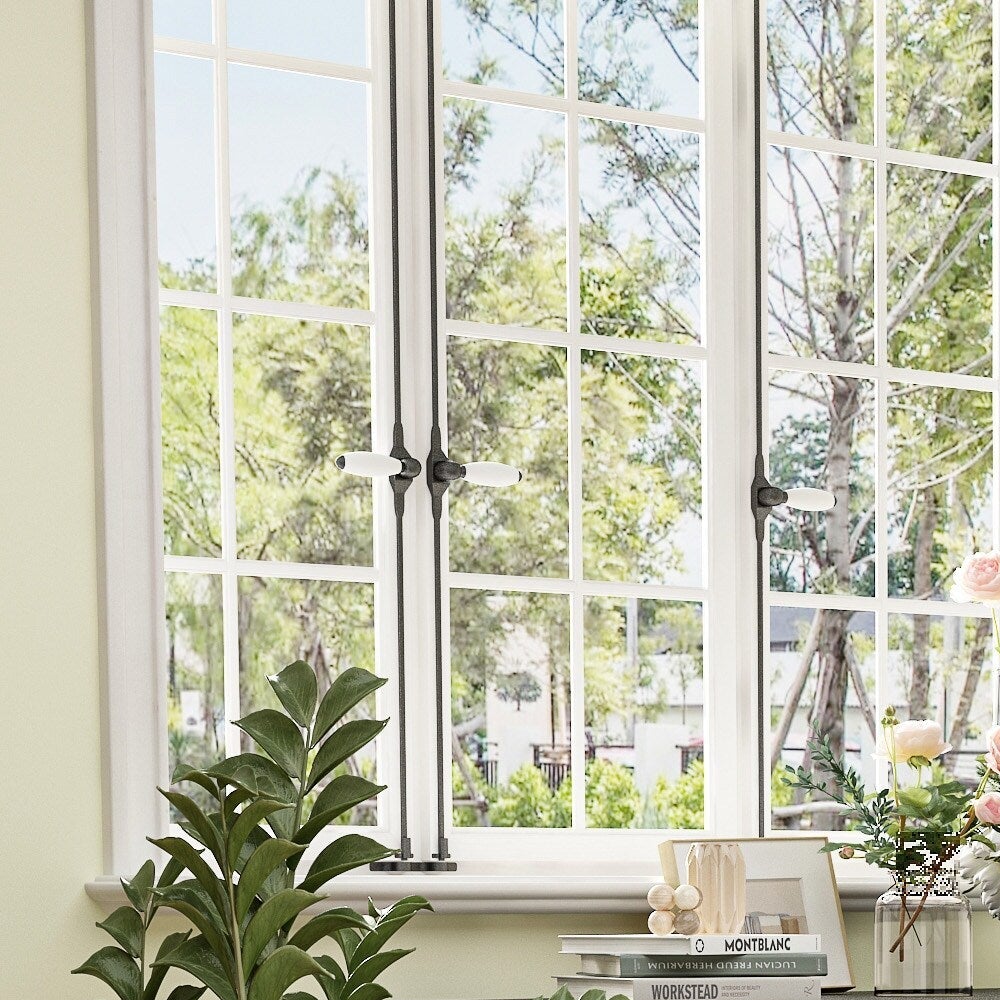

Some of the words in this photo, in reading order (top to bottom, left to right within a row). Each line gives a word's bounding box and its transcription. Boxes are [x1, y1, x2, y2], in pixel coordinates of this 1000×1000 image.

[724, 938, 791, 952] MONTBLANC
[648, 962, 713, 970] HERBARIUM
[716, 961, 752, 970] FREUD
[755, 961, 797, 969] LUCIAN
[651, 984, 719, 1000] WORKSTEAD
